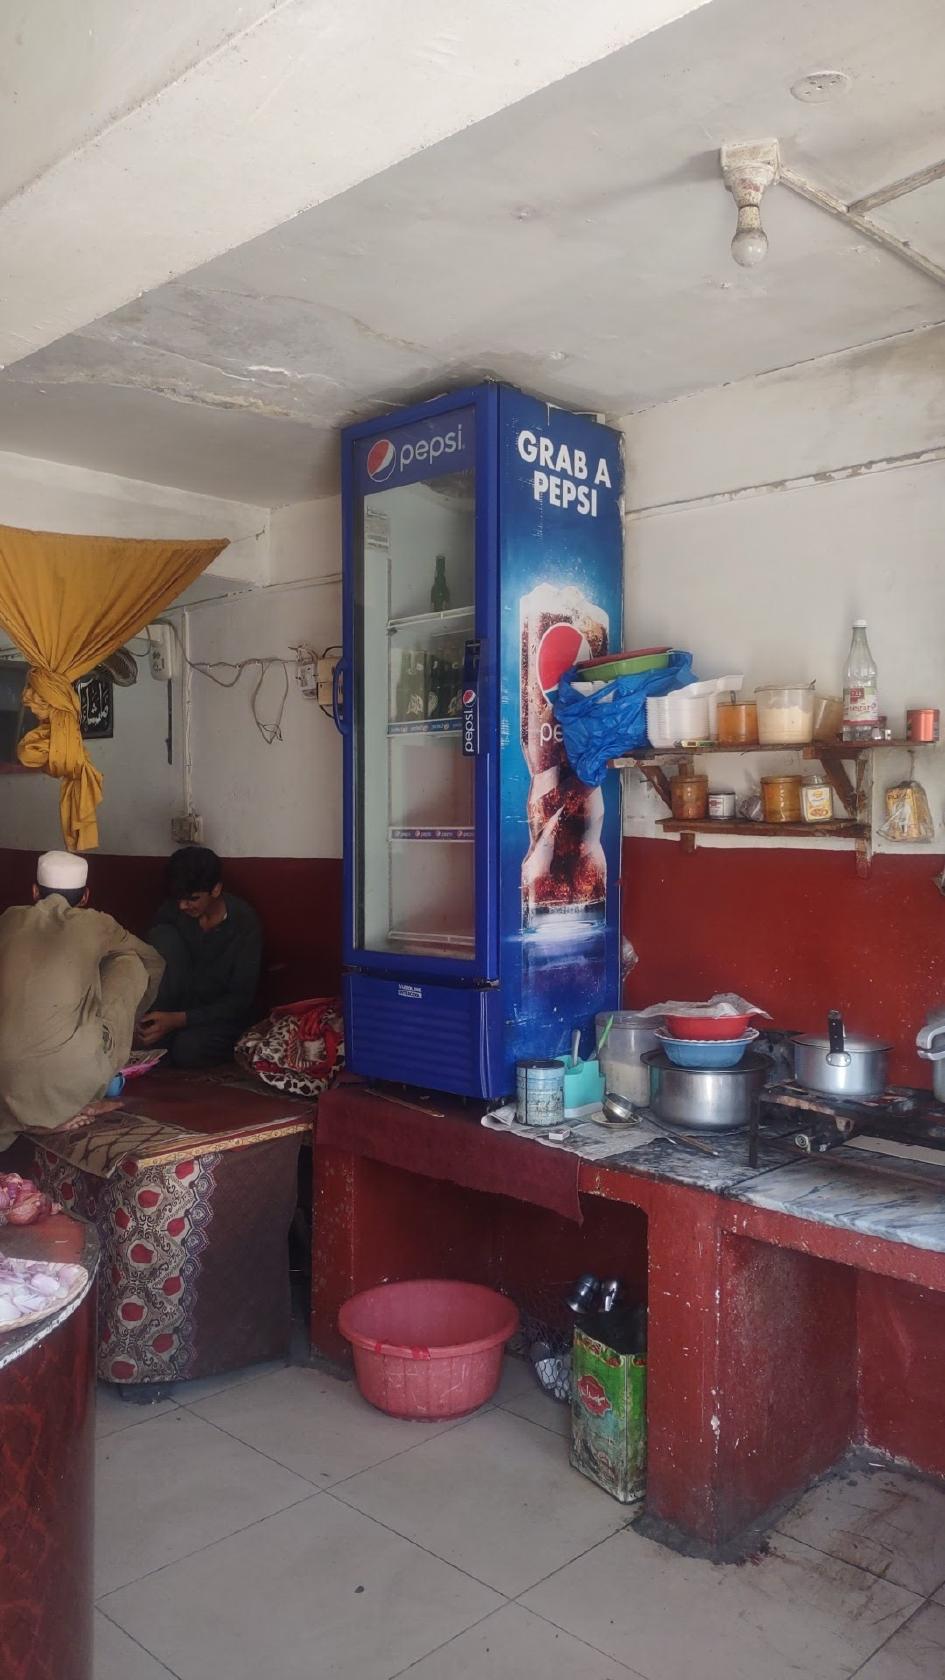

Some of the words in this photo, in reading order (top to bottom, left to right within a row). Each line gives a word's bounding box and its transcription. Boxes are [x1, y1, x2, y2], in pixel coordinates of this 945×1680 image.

[400, 424, 464, 472] pepsi
[517, 430, 588, 480] GRAB
[595, 458, 612, 488] A
[533, 471, 598, 517] PEPSI
[464, 708, 475, 753] pepsi
